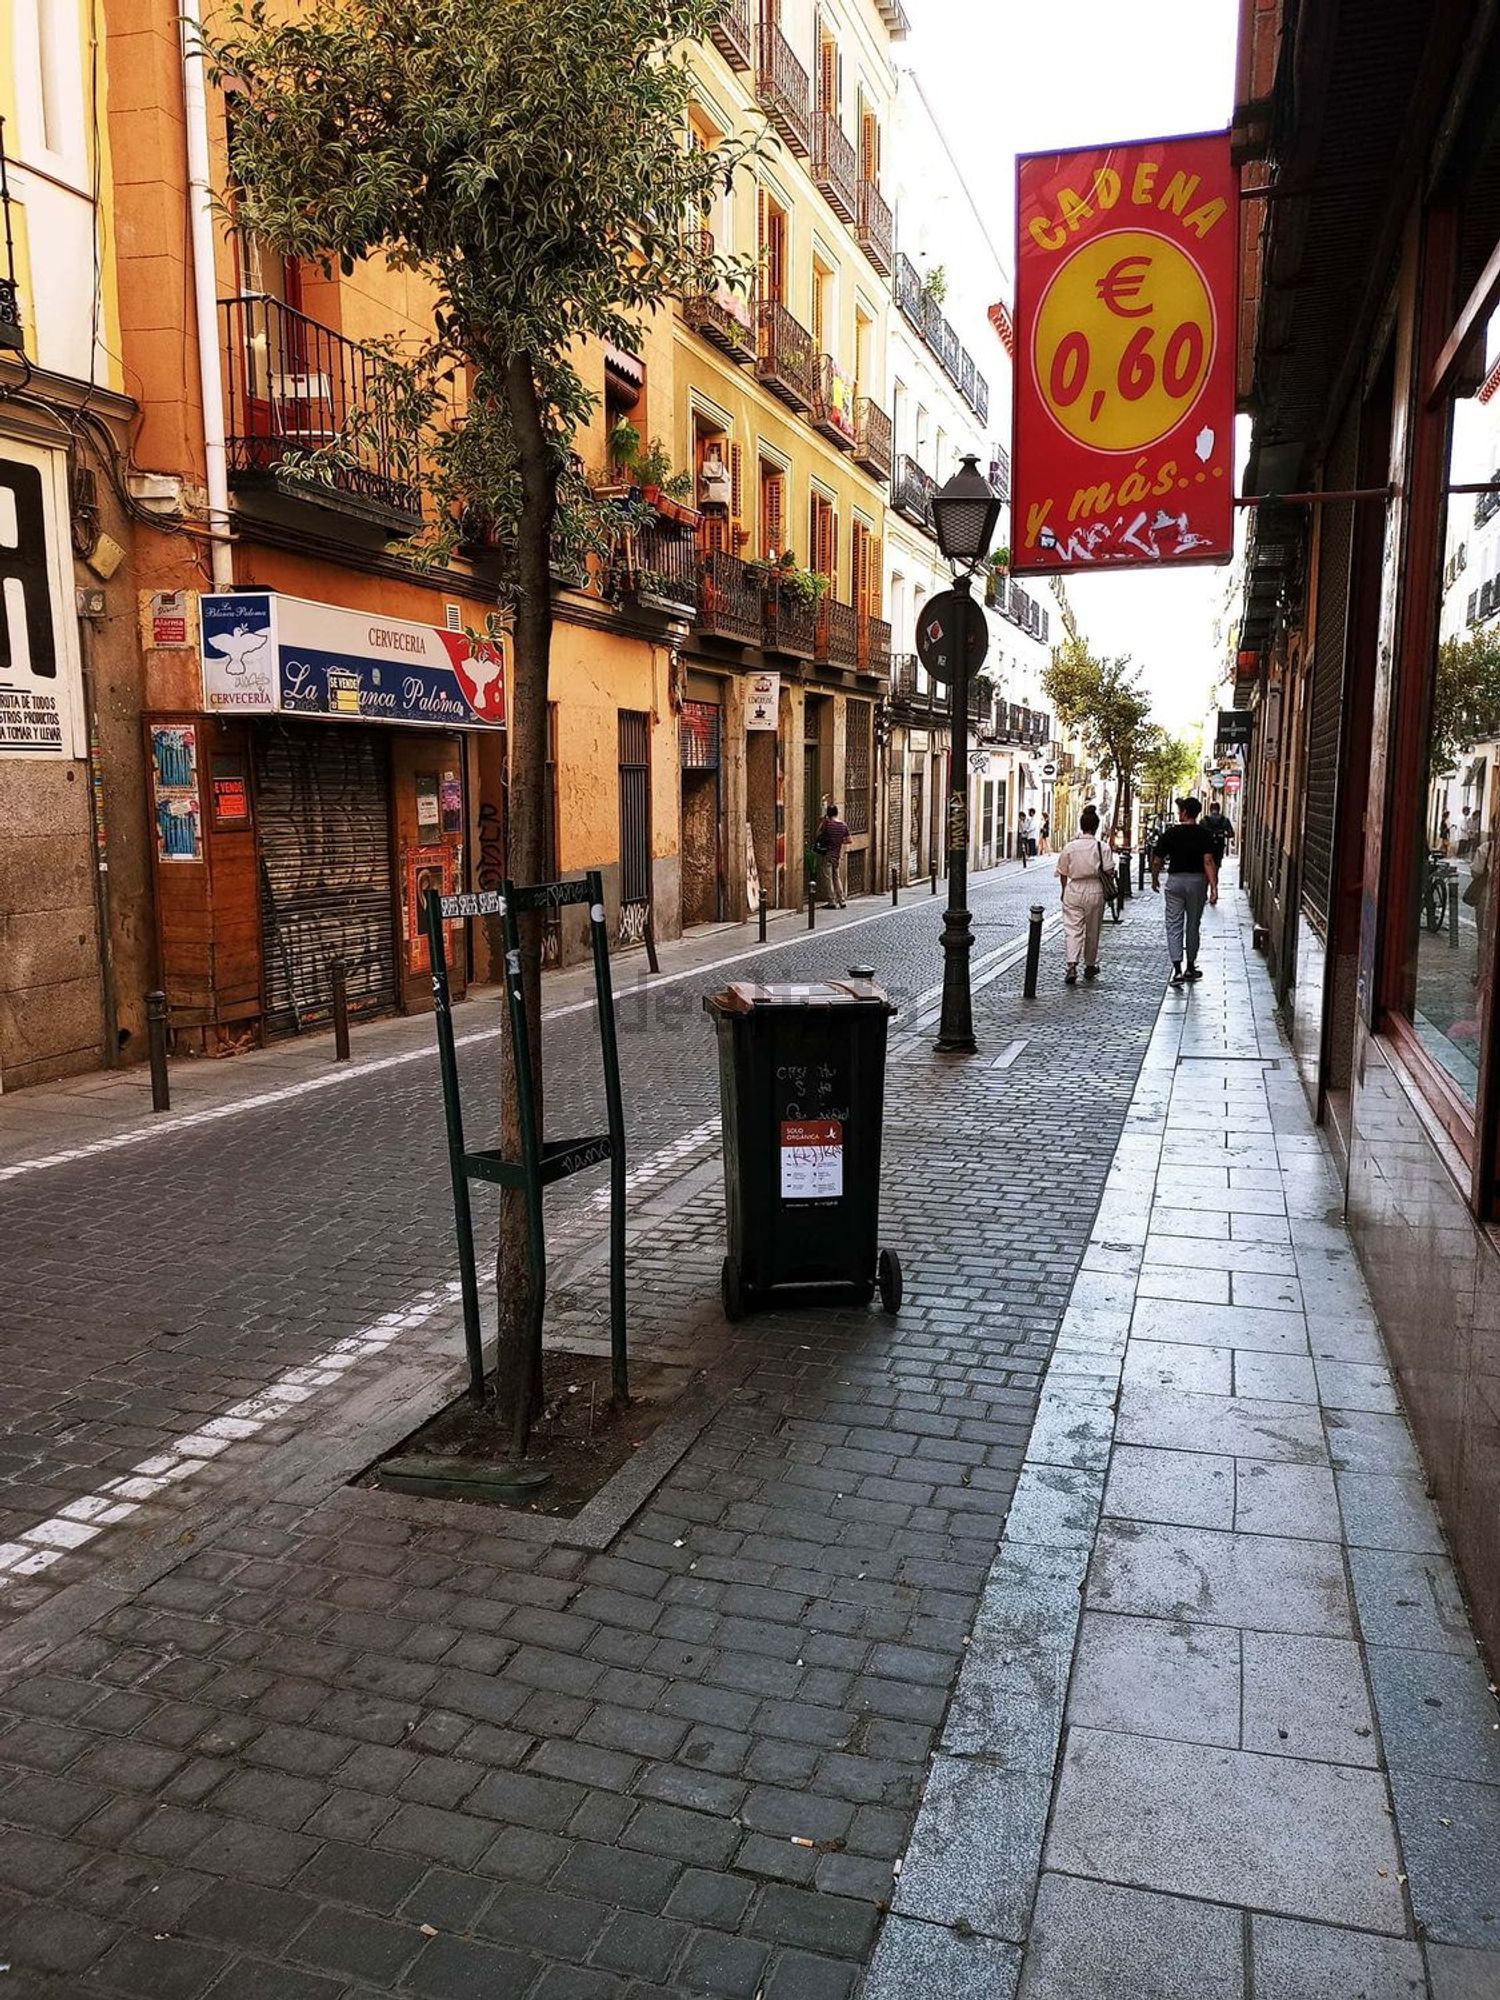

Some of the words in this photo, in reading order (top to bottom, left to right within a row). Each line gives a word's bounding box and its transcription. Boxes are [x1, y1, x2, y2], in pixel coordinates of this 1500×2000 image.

[1028, 162, 1228, 251] CADENA
[1095, 255, 1153, 318] €
[1050, 321, 1204, 423] 0,60
[235, 605, 267, 618] Paloma
[283, 661, 319, 701] La
[402, 676, 462, 713] Paloma
[330, 675, 339, 689] SE
[339, 677, 358, 690] VENDE
[21, 695, 31, 709] DE
[31, 696, 56, 710] TODOS
[7, 726, 33, 740] TOMAR
[33, 727, 39, 740] Y
[220, 781, 243, 794] VENDE
